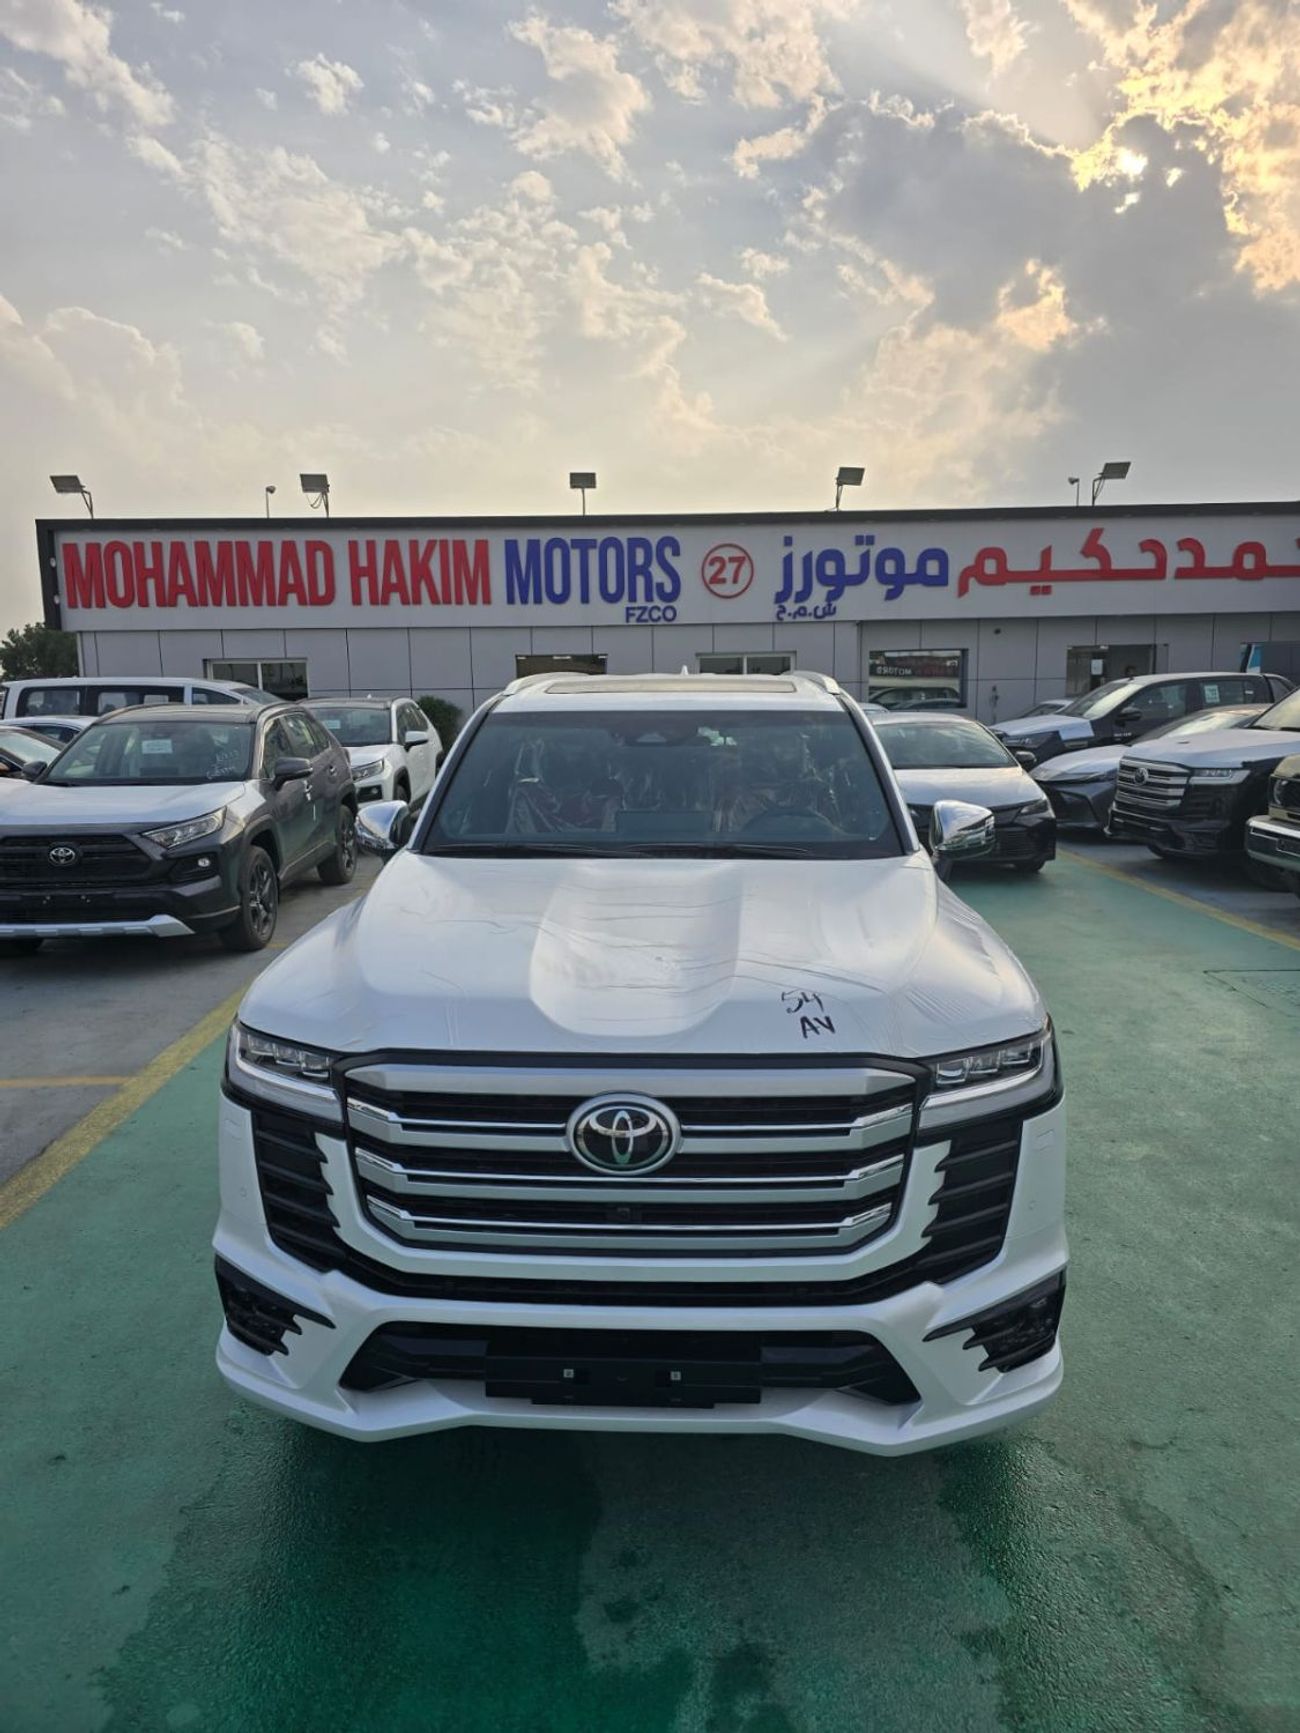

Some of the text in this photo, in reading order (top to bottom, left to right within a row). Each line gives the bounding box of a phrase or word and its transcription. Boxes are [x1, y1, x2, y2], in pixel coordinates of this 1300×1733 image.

[63, 536, 681, 608] MOHAMMAD HAKIM MOTORS
[709, 556, 746, 585] 27
[774, 528, 1300, 604] مد حكيم موتورز
[625, 605, 678, 624] FZCO
[781, 989, 825, 1014] 54
